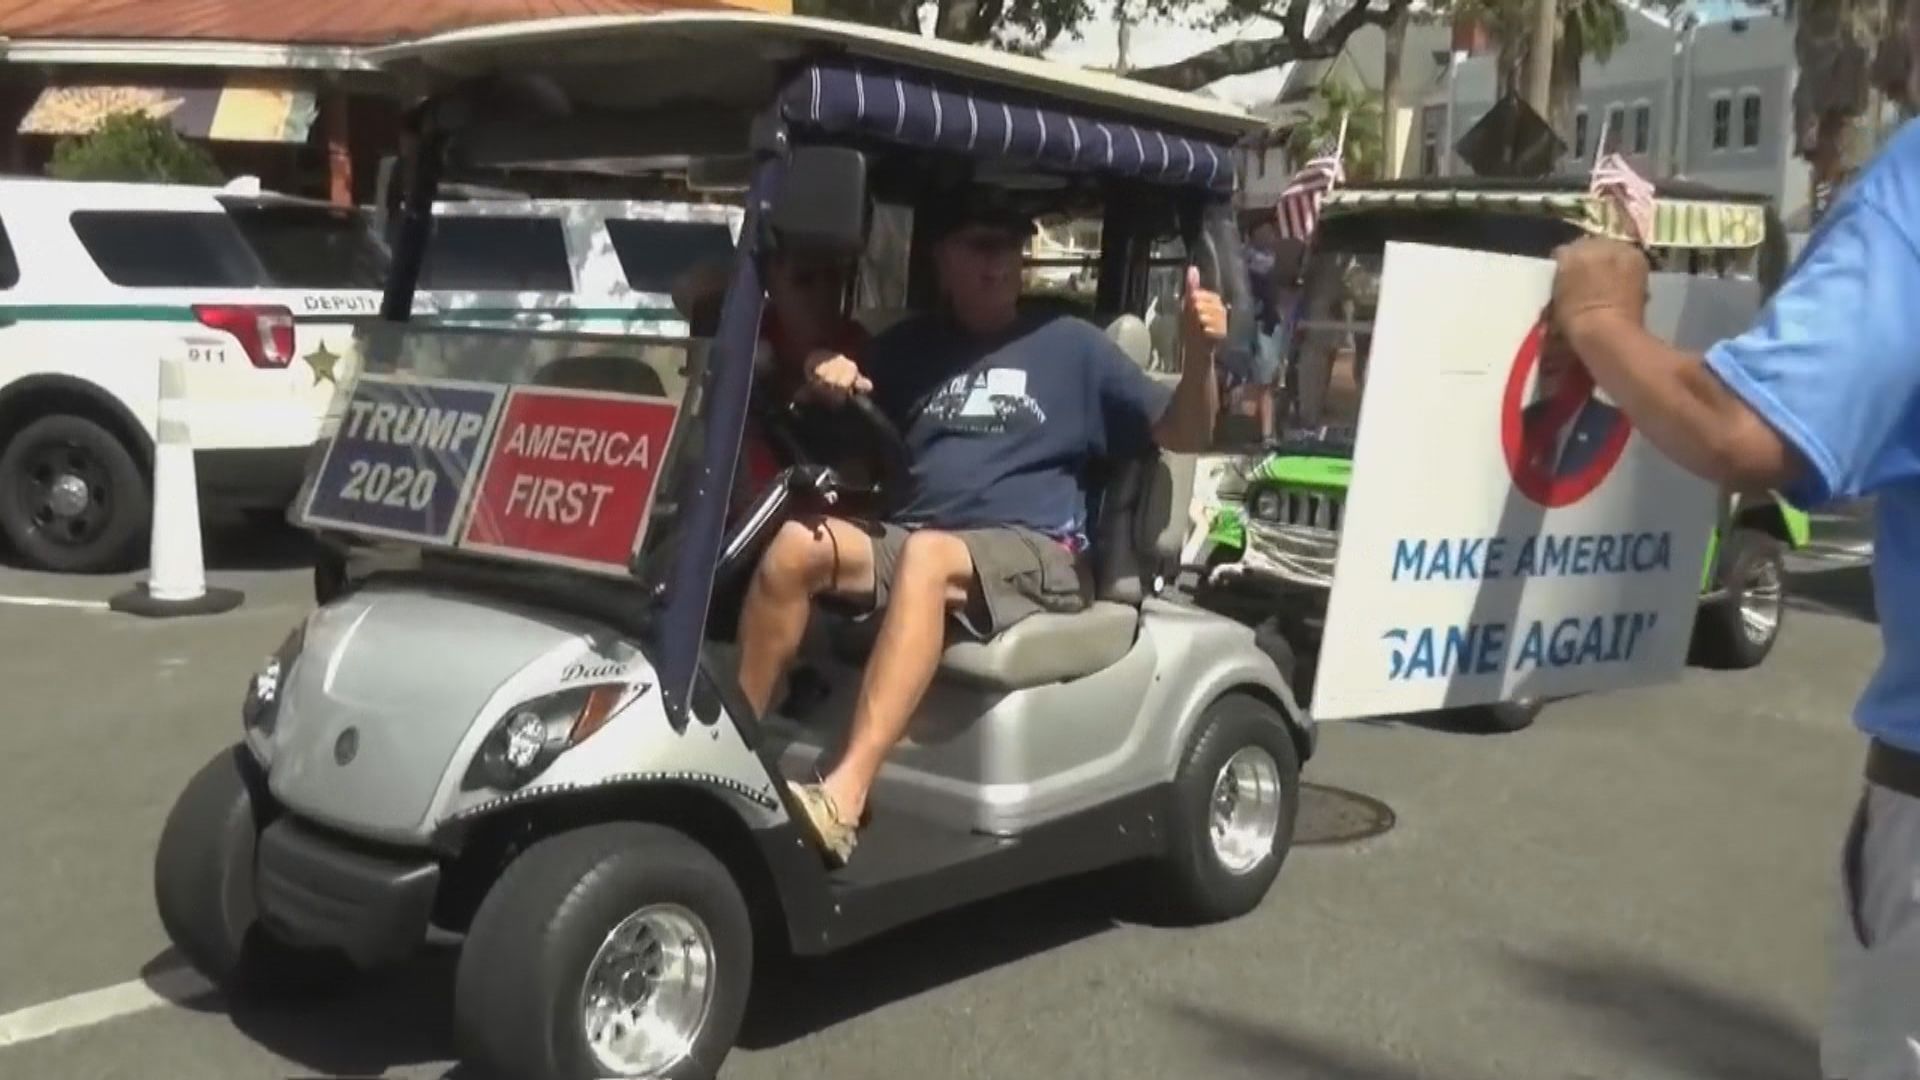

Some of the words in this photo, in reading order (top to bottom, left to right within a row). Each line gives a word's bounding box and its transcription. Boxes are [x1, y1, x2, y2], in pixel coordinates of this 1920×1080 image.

[347, 401, 484, 452] TRUMP
[504, 422, 650, 470] AMERICA
[340, 460, 437, 512] 2020
[505, 474, 614, 528] FIRST
[1392, 536, 1506, 582] MAKE
[1513, 531, 1672, 578] AMERICA
